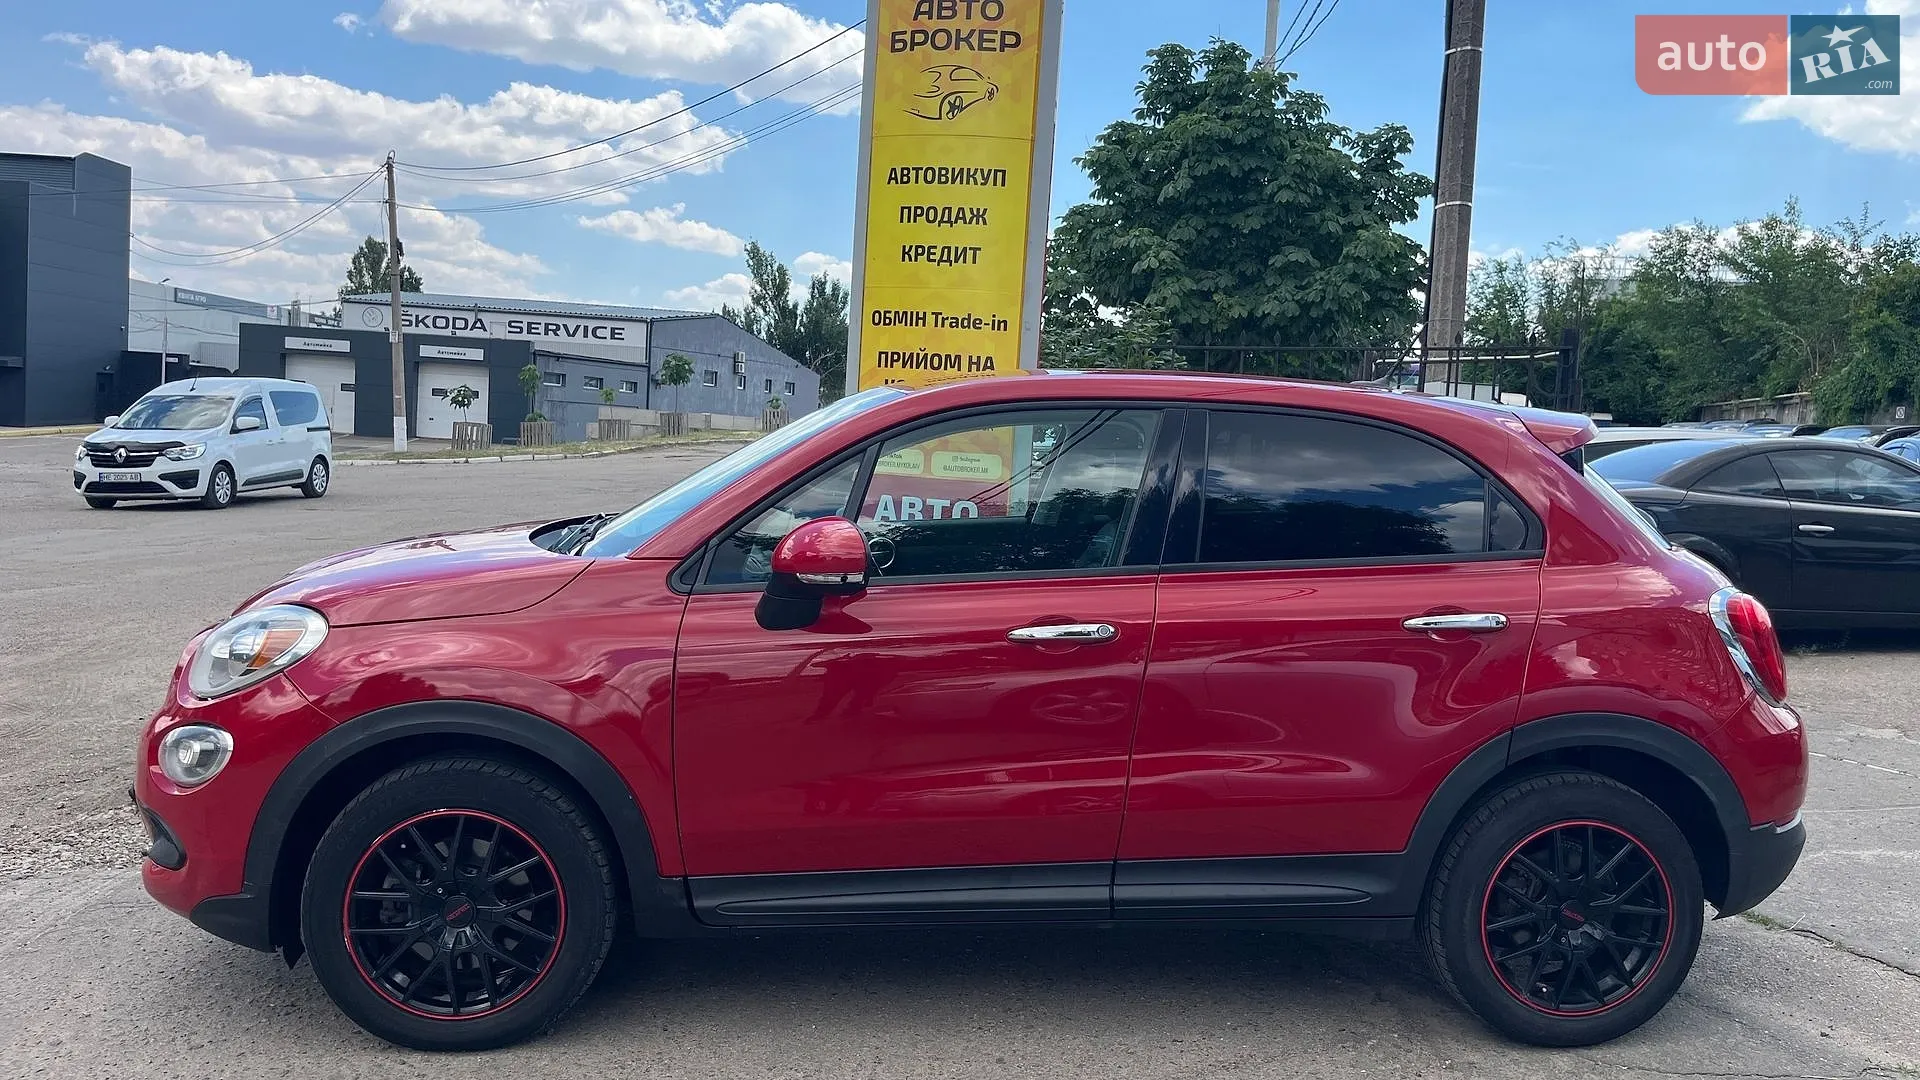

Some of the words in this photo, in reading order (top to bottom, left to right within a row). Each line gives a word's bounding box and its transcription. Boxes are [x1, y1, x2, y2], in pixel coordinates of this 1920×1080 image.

[912, 0, 1006, 22] АВТО
[890, 28, 1022, 54] БРОКЕР
[887, 166, 1007, 188] АВТОВИКУП
[899, 205, 989, 228] ПРОДАЖ
[901, 244, 982, 267] КРЕДИТ
[401, 309, 488, 333] ŠKODA
[507, 319, 625, 341] SERVICE
[871, 309, 927, 328] ОБМІН
[931, 311, 1008, 332] Trade-in
[877, 347, 962, 373] ПРИЙОМ
[967, 354, 995, 372] НА
